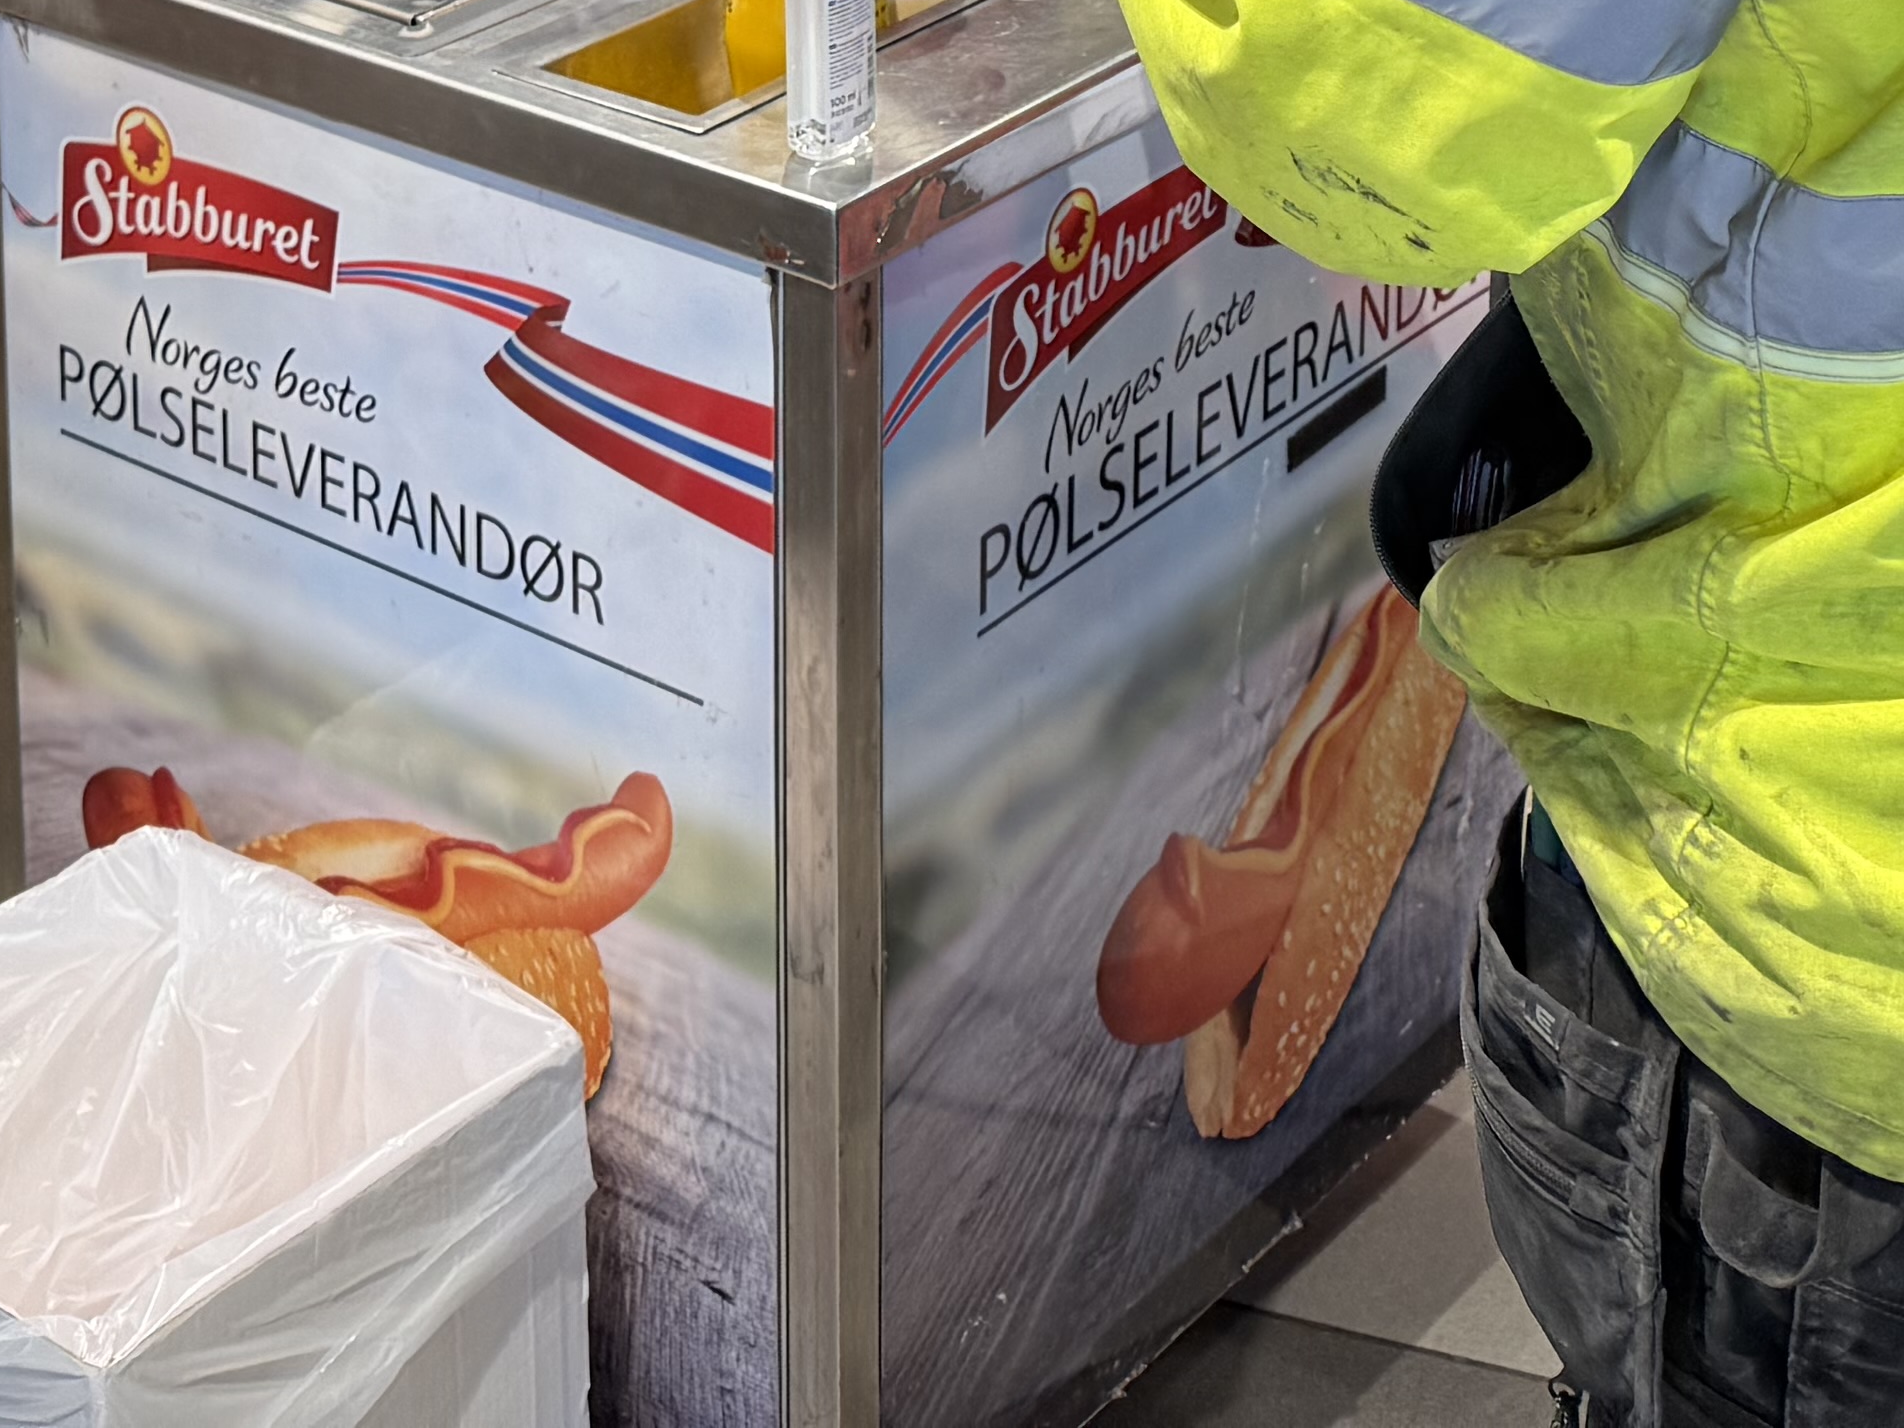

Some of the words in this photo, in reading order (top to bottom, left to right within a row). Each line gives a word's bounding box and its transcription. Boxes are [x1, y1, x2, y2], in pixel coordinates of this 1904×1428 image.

[71, 157, 319, 271] Stabburet
[125, 295, 260, 389] Norges
[275, 347, 377, 424] beste
[978, 277, 1477, 616] PØLSELEVERAND
[1043, 355, 1163, 474] Norges
[1177, 287, 1256, 372] beste
[58, 345, 606, 626] PØLSELEVERANDØR
